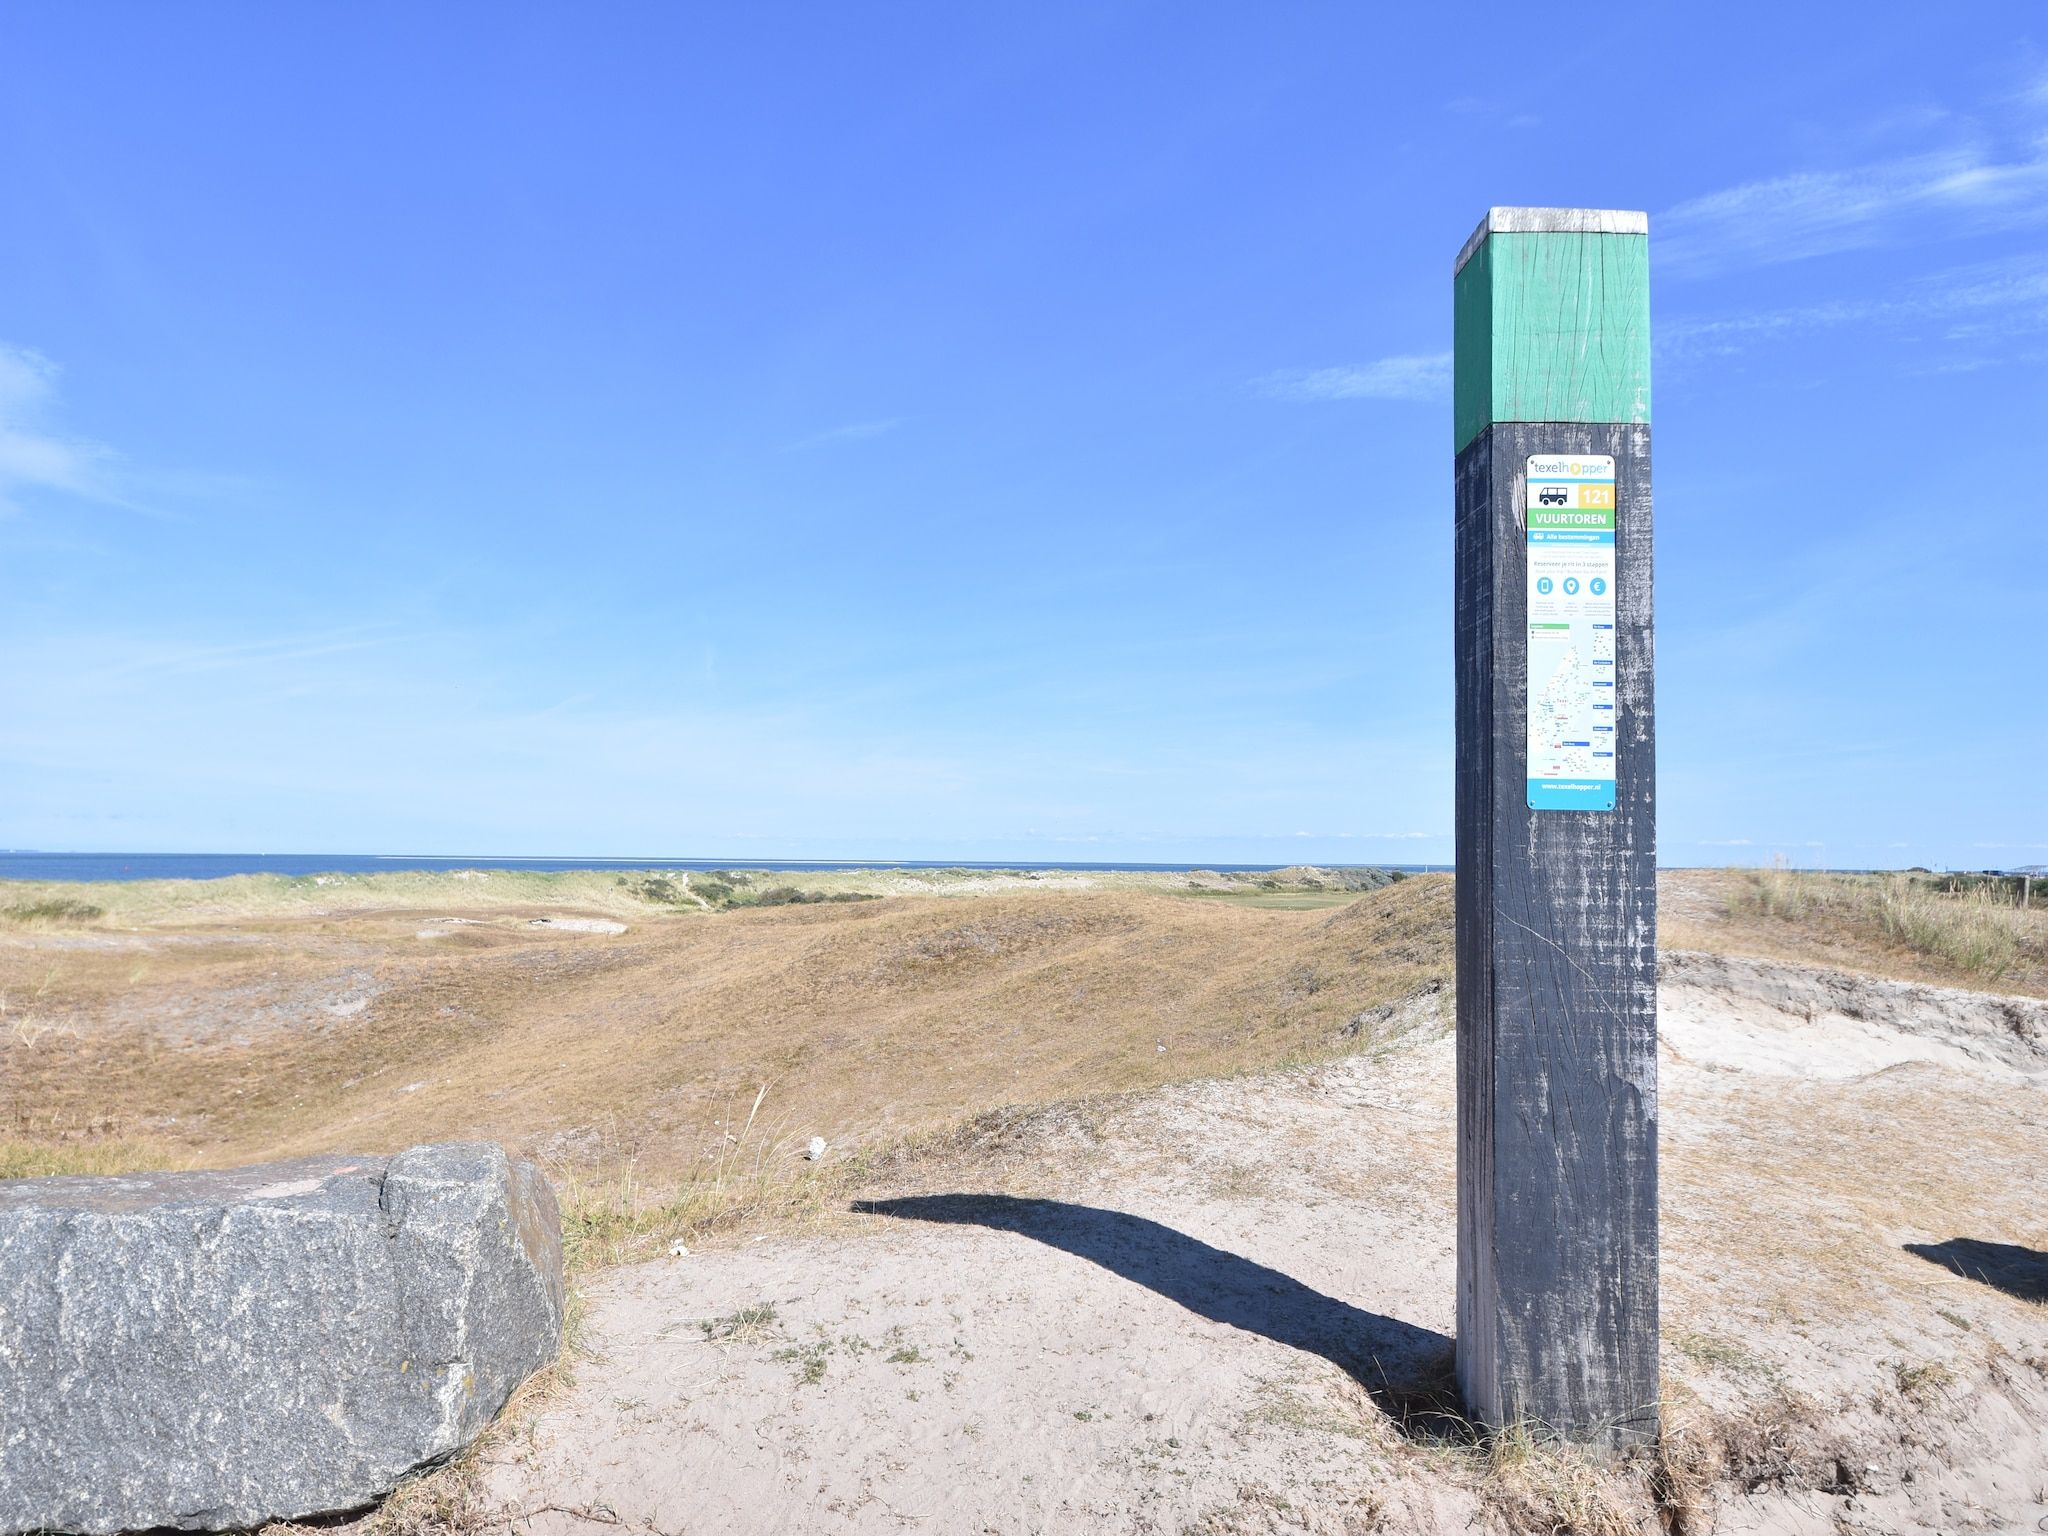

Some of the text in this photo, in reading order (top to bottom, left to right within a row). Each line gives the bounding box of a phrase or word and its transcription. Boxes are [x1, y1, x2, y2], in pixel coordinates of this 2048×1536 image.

[1535, 461, 1607, 475] texelhopper
[1584, 489, 1609, 504] 121
[1535, 514, 1606, 524] VUURTOREN
[1541, 783, 1601, 791] www.texelhopper.nl
